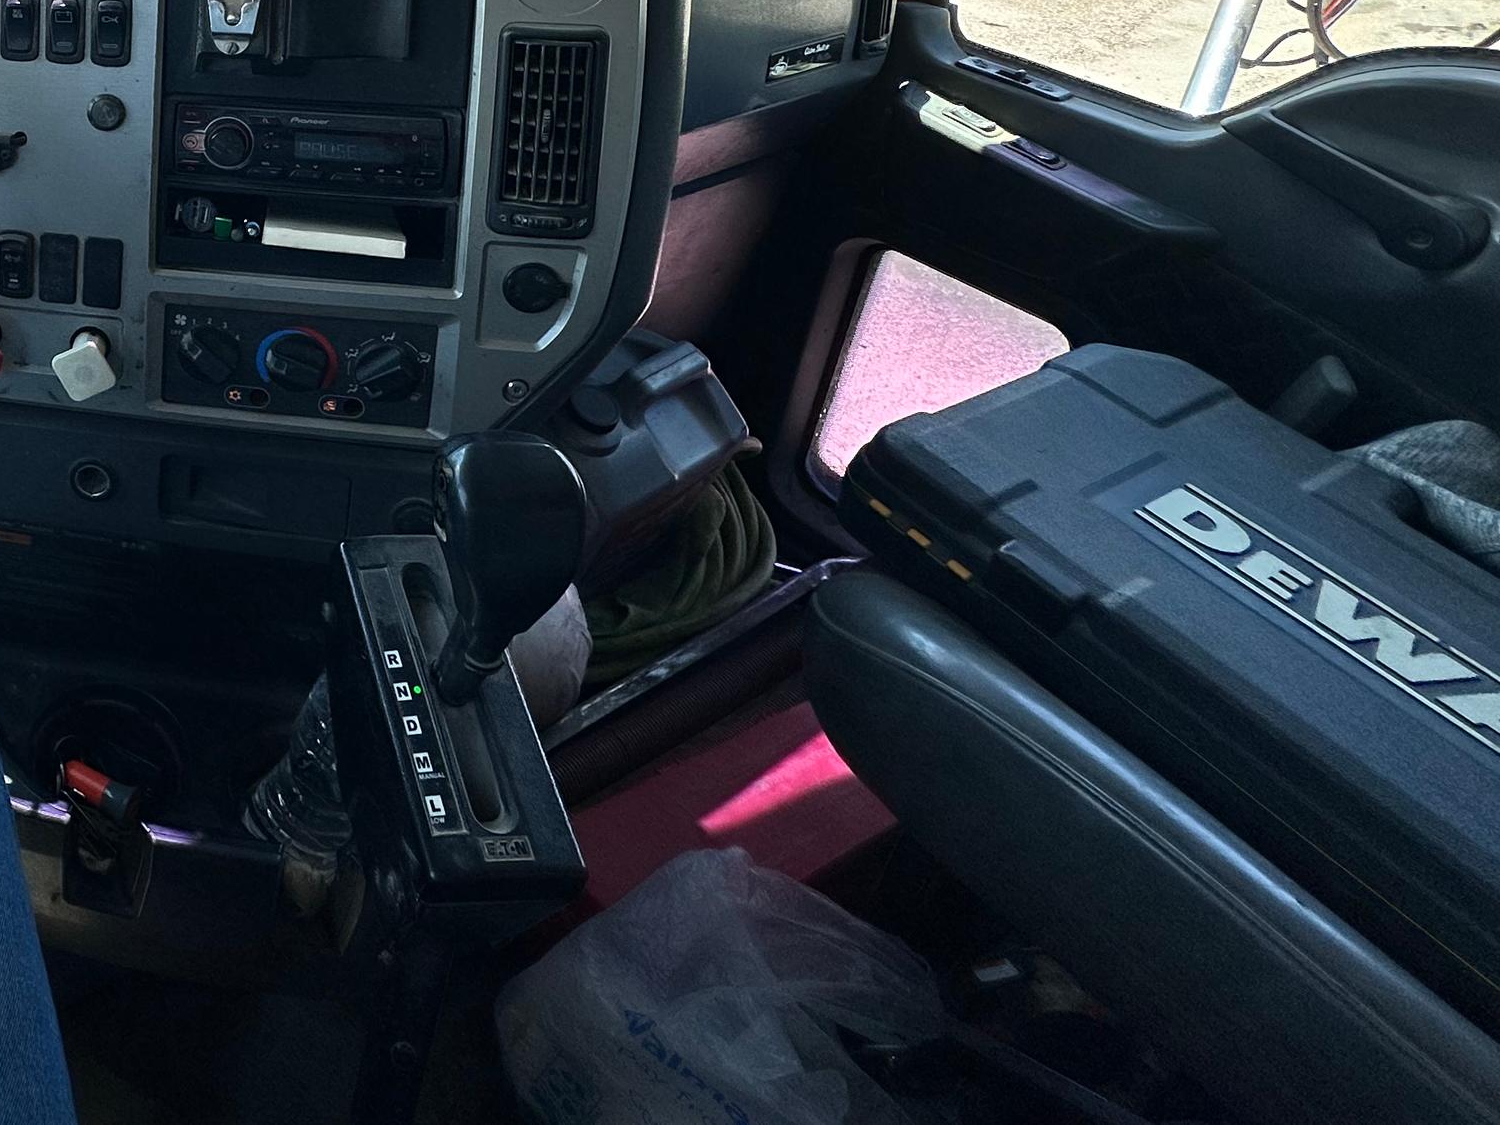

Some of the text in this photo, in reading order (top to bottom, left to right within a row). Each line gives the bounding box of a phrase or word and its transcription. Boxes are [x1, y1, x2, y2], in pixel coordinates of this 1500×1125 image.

[289, 116, 331, 126] Pioneer
[418, 772, 446, 780] MANUAL
[430, 817, 445, 825] LOW
